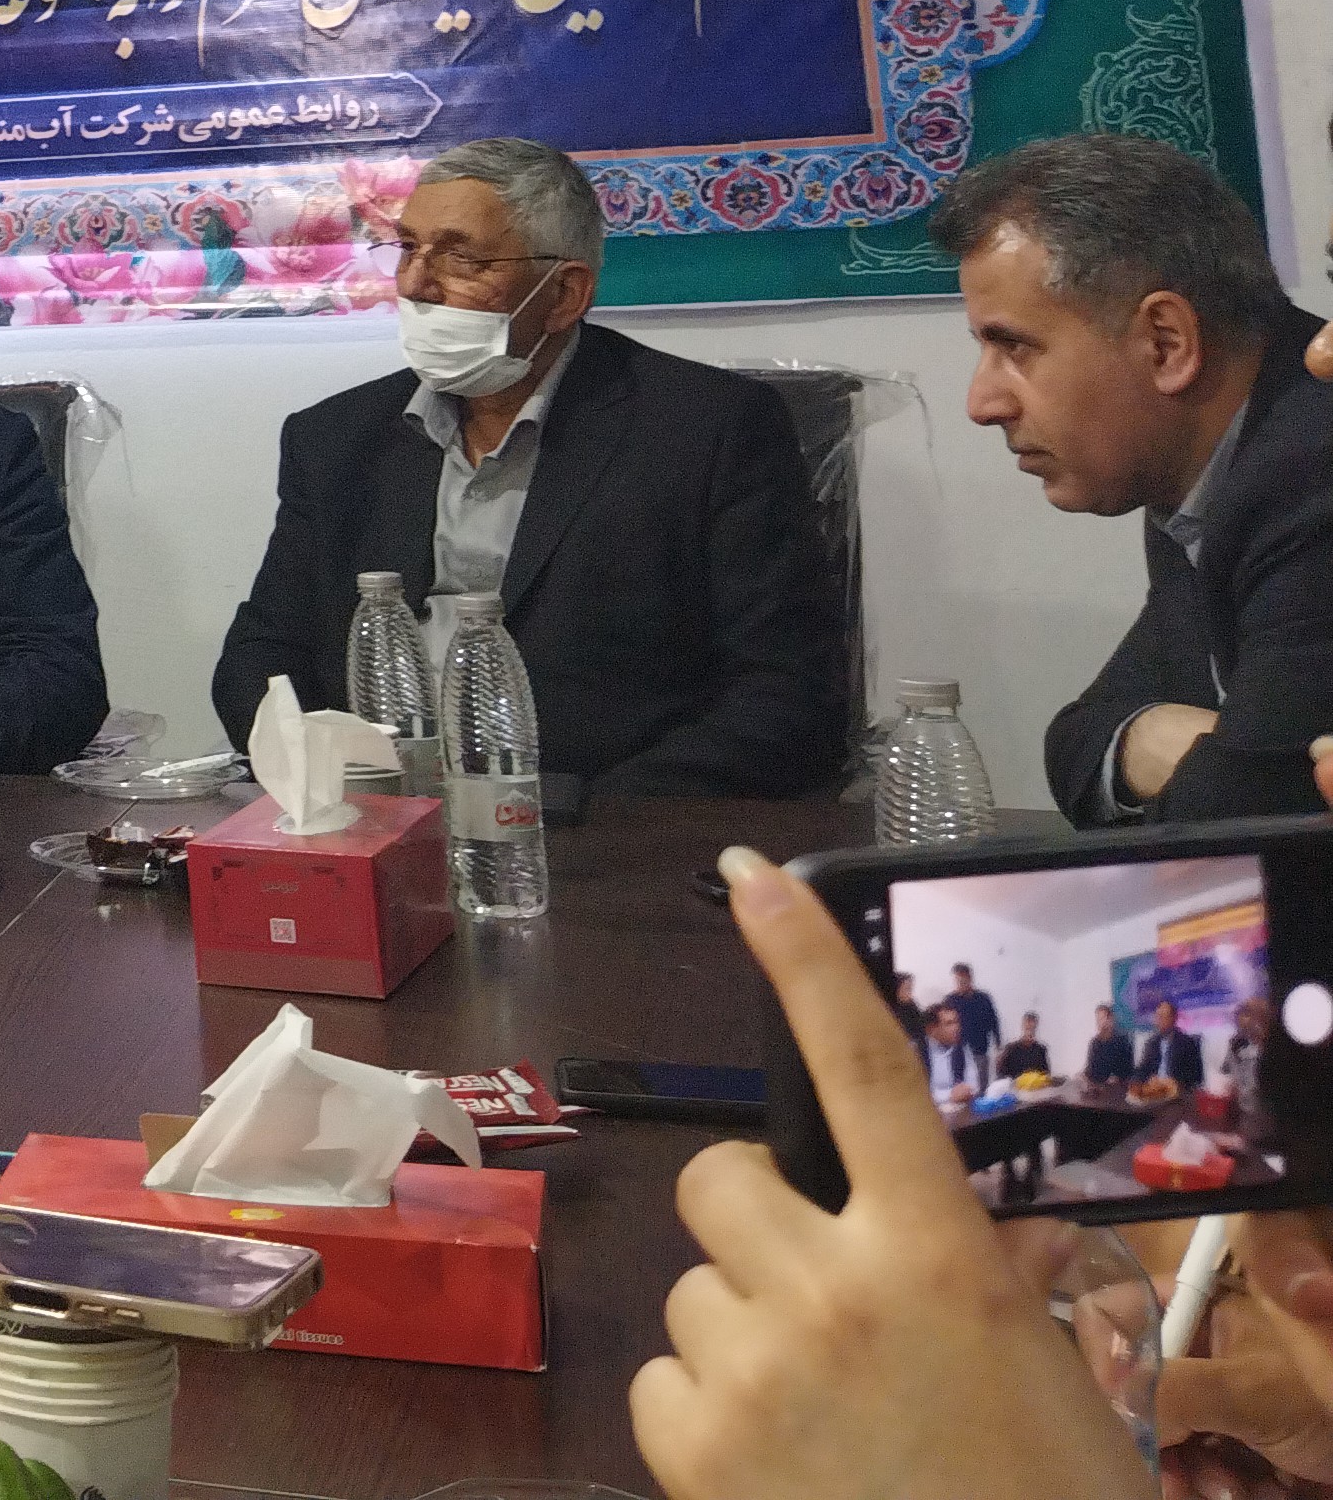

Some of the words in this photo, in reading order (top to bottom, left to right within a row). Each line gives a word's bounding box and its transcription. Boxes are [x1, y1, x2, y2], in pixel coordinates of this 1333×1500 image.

[25, 104, 77, 150] آب
[80, 103, 175, 146] شرکت
[178, 103, 287, 143] عمومی
[291, 93, 380, 131] روابط
[434, 1074, 507, 1093] NESCA
